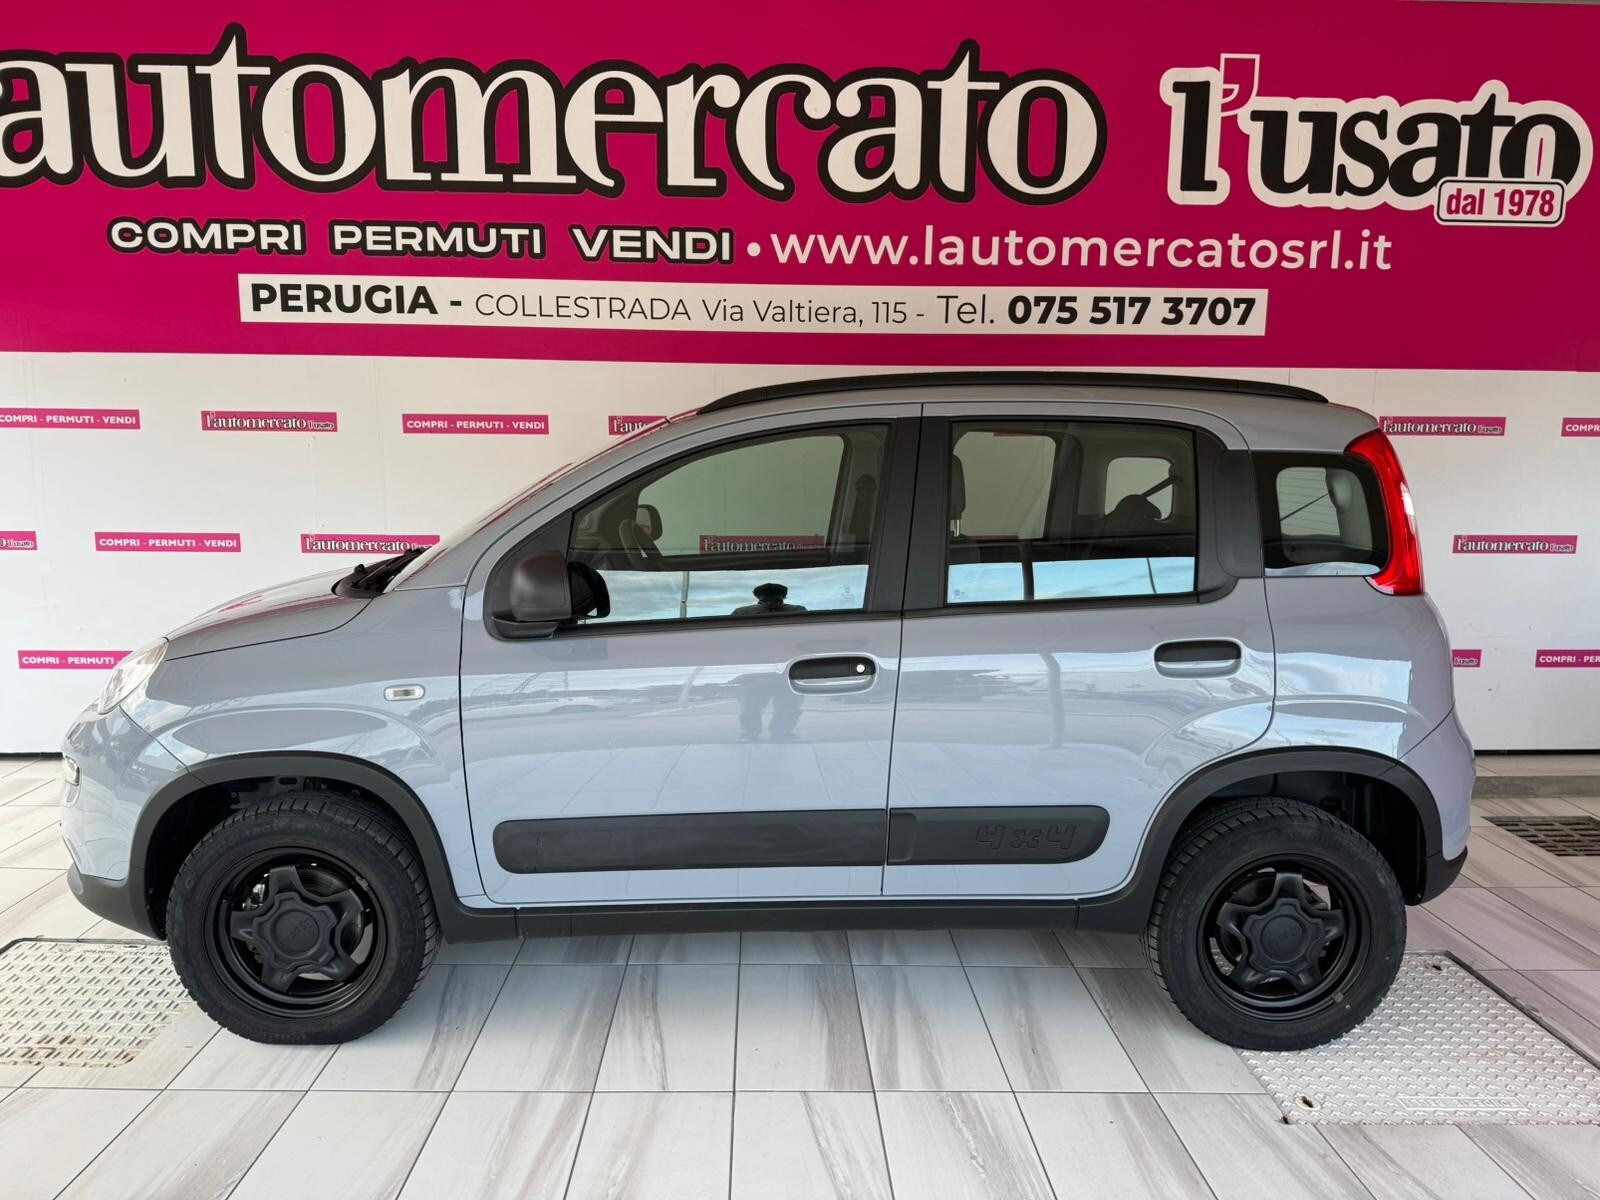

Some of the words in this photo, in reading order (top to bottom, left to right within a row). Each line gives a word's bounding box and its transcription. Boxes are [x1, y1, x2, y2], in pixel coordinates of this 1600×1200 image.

[1166, 53, 1585, 205] l'usato
[1446, 188, 1484, 216] dal
[1494, 189, 1555, 217] 1978
[110, 220, 303, 253] COMPRI
[332, 223, 543, 256] PERMUTI
[571, 227, 732, 261] VENDI
[770, 225, 1392, 270] www.lautomercatosrl.it
[251, 283, 438, 315] PERUGIA
[475, 294, 691, 320] COLLESTRADA
[702, 299, 744, 322] Via
[752, 298, 864, 328] Valtiera,
[871, 301, 907, 325] 115
[937, 295, 995, 325] Tel.
[1007, 296, 1075, 325] 075
[1088, 296, 1151, 325] 517
[1160, 297, 1256, 326] 3707
[0, 414, 38, 423] COMPRI
[45, 415, 94, 424] PERMUTI
[102, 416, 136, 424] VENDI
[206, 411, 307, 429] l'automercato
[406, 420, 448, 429] COMPRI
[456, 421, 504, 429] PERMUTI
[511, 421, 545, 430] VENDI
[99, 538, 140, 547] COMPRI
[148, 539, 196, 547] PERMUTI
[203, 540, 237, 548] VENDI
[305, 534, 410, 551] l'automercato
[22, 656, 60, 665] COMPRI
[67, 656, 115, 665] PERMUTI
[1539, 655, 1576, 663] COMPRI
